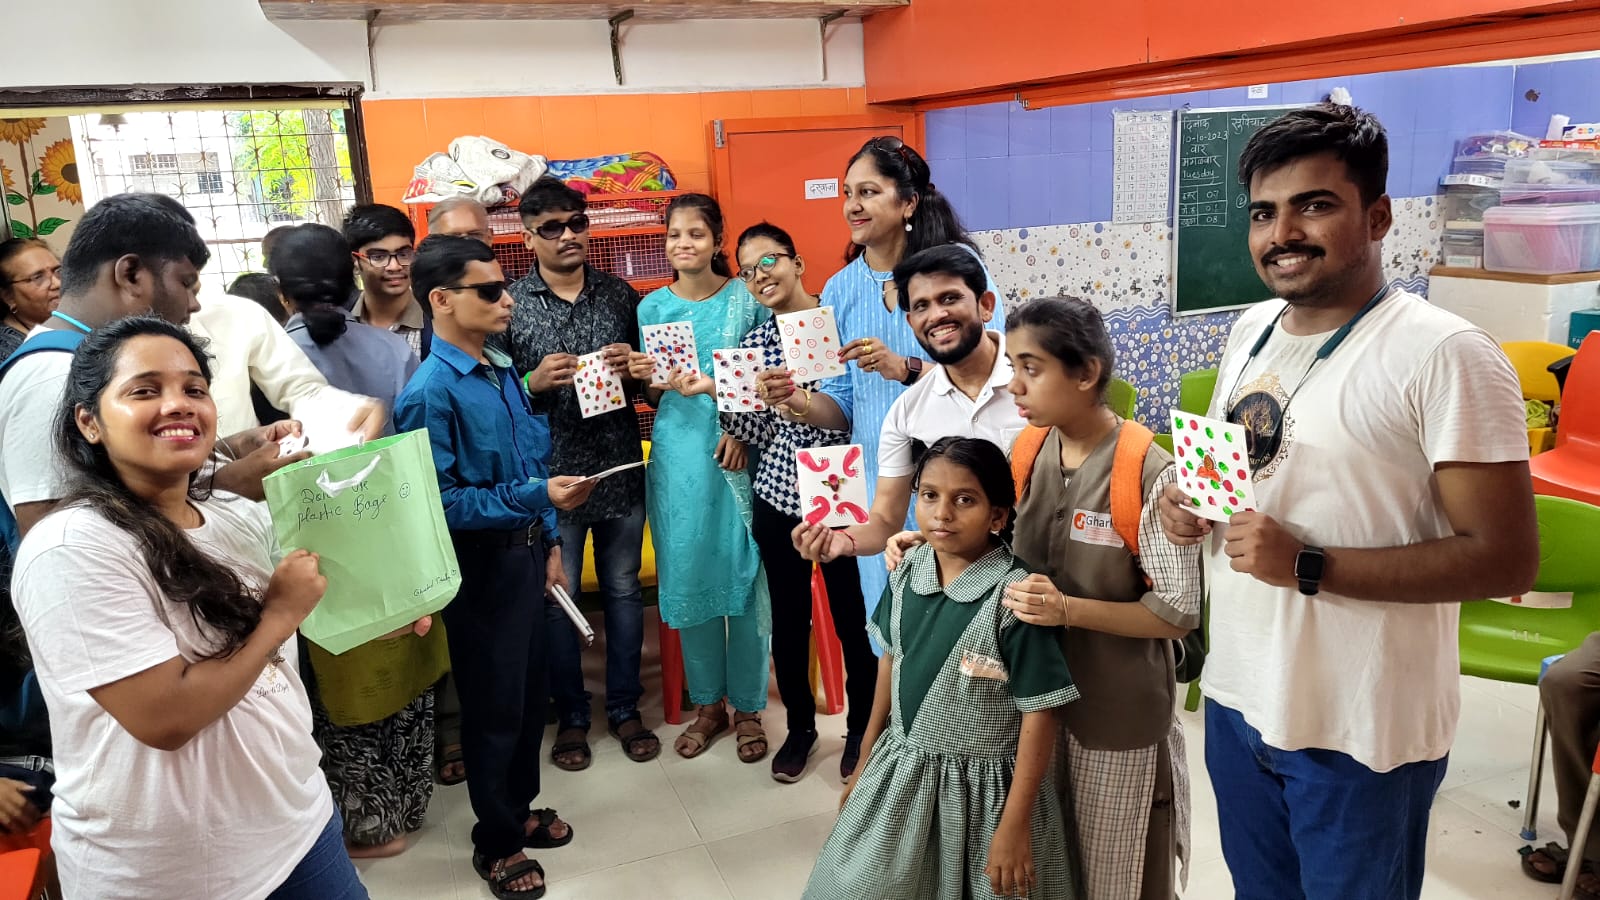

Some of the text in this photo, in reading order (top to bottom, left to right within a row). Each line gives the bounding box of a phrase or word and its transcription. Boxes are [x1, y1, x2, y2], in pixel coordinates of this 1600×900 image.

[1182, 115, 1212, 132] दिनांक
[1183, 131, 1228, 144] 10-10-2023
[1190, 143, 1208, 155] वार
